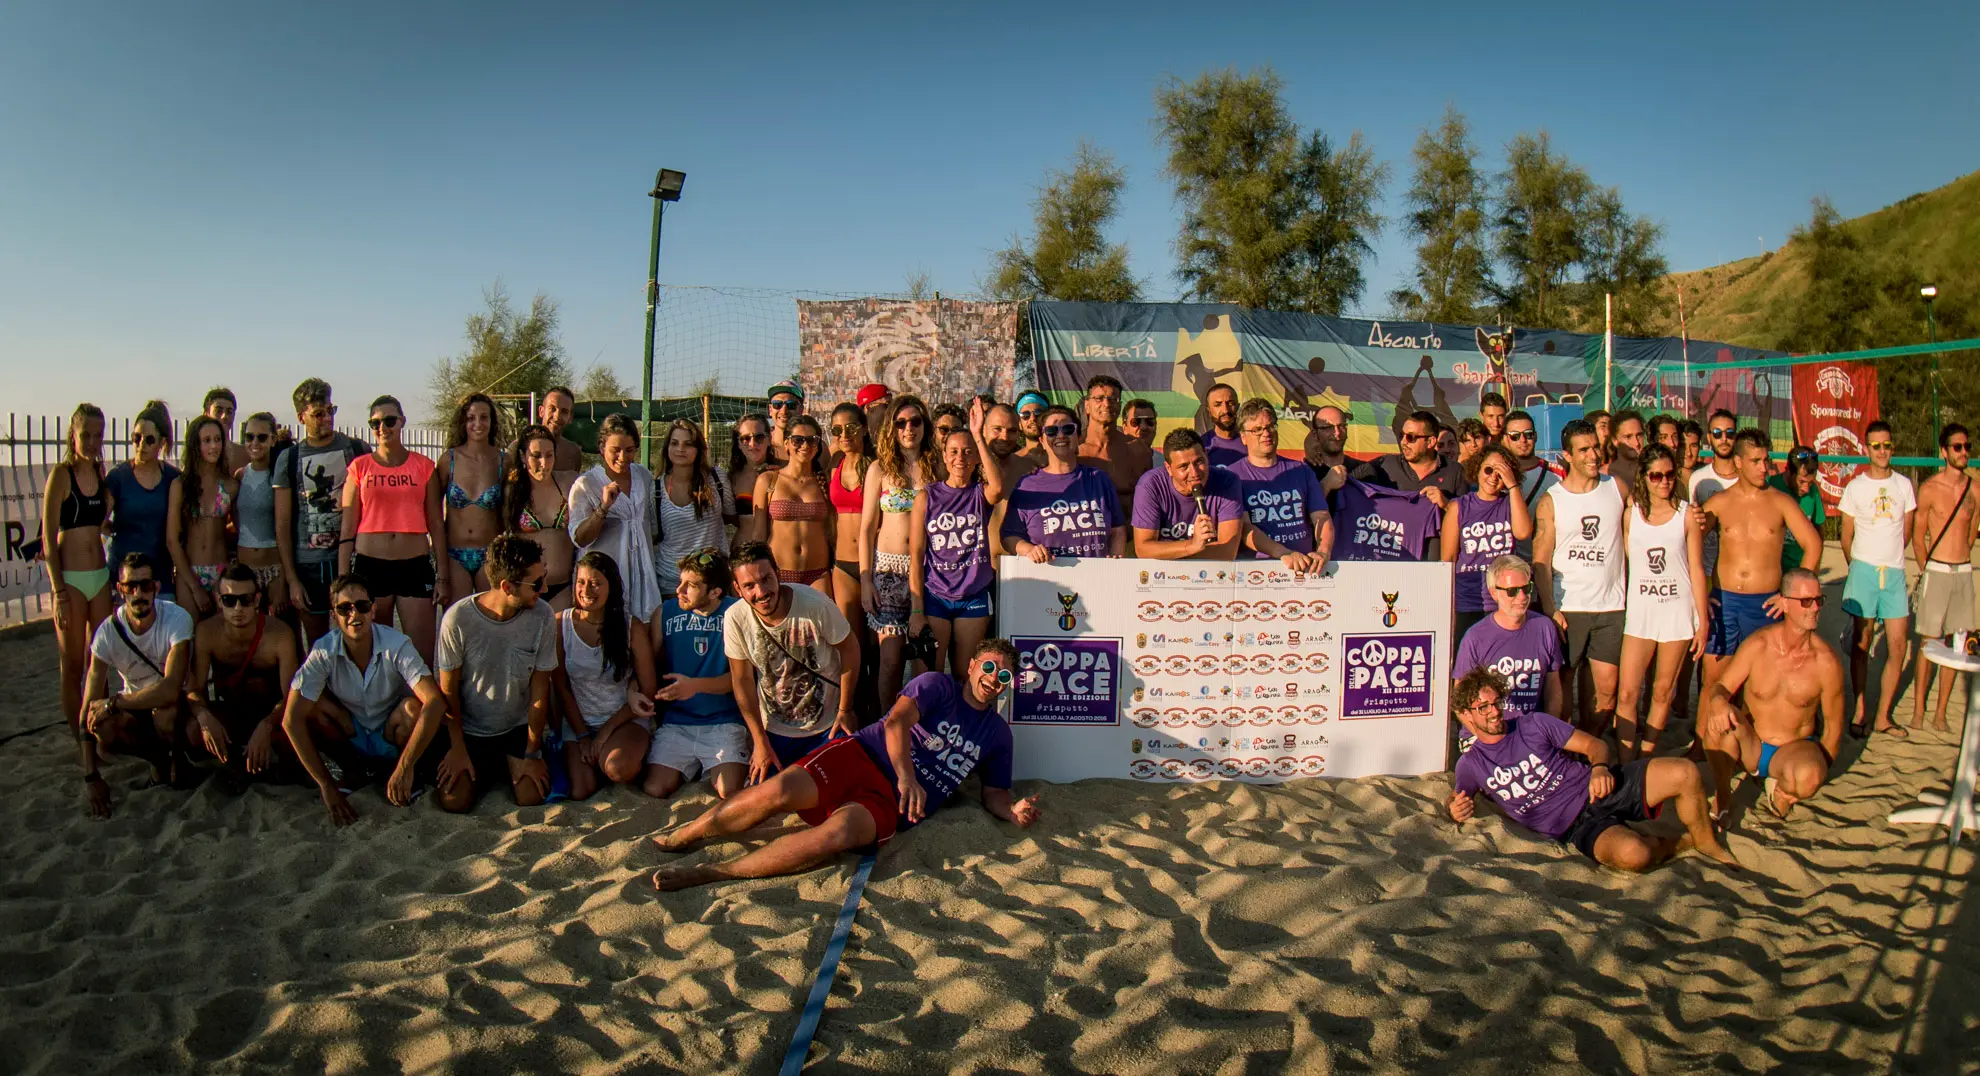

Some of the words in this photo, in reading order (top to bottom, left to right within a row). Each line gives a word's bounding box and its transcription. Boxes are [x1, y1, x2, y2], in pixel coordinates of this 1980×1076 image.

[1810, 403, 1853, 419] Sponsored
[366, 474, 418, 488] FITGIRL
[1247, 489, 1302, 506] COPPA
[1040, 499, 1101, 517] COPPA
[1256, 503, 1303, 523] PACE
[1049, 512, 1106, 534] PACE
[1356, 513, 1405, 534] COPPA
[1462, 520, 1511, 538] COPPA
[1052, 543, 1105, 556] rispetto
[1358, 530, 1404, 550] PACE
[1466, 533, 1513, 554] PACE
[1568, 549, 1605, 562] PACE
[1640, 584, 1678, 596] PACE
[1020, 643, 1111, 671] COPPA
[1347, 639, 1426, 667] COPPA
[1025, 670, 1111, 694] PACE
[1354, 665, 1426, 689] PACE
[927, 736, 976, 778] PACE
[1486, 753, 1542, 790] COPPA
[1496, 765, 1549, 801] PACE
